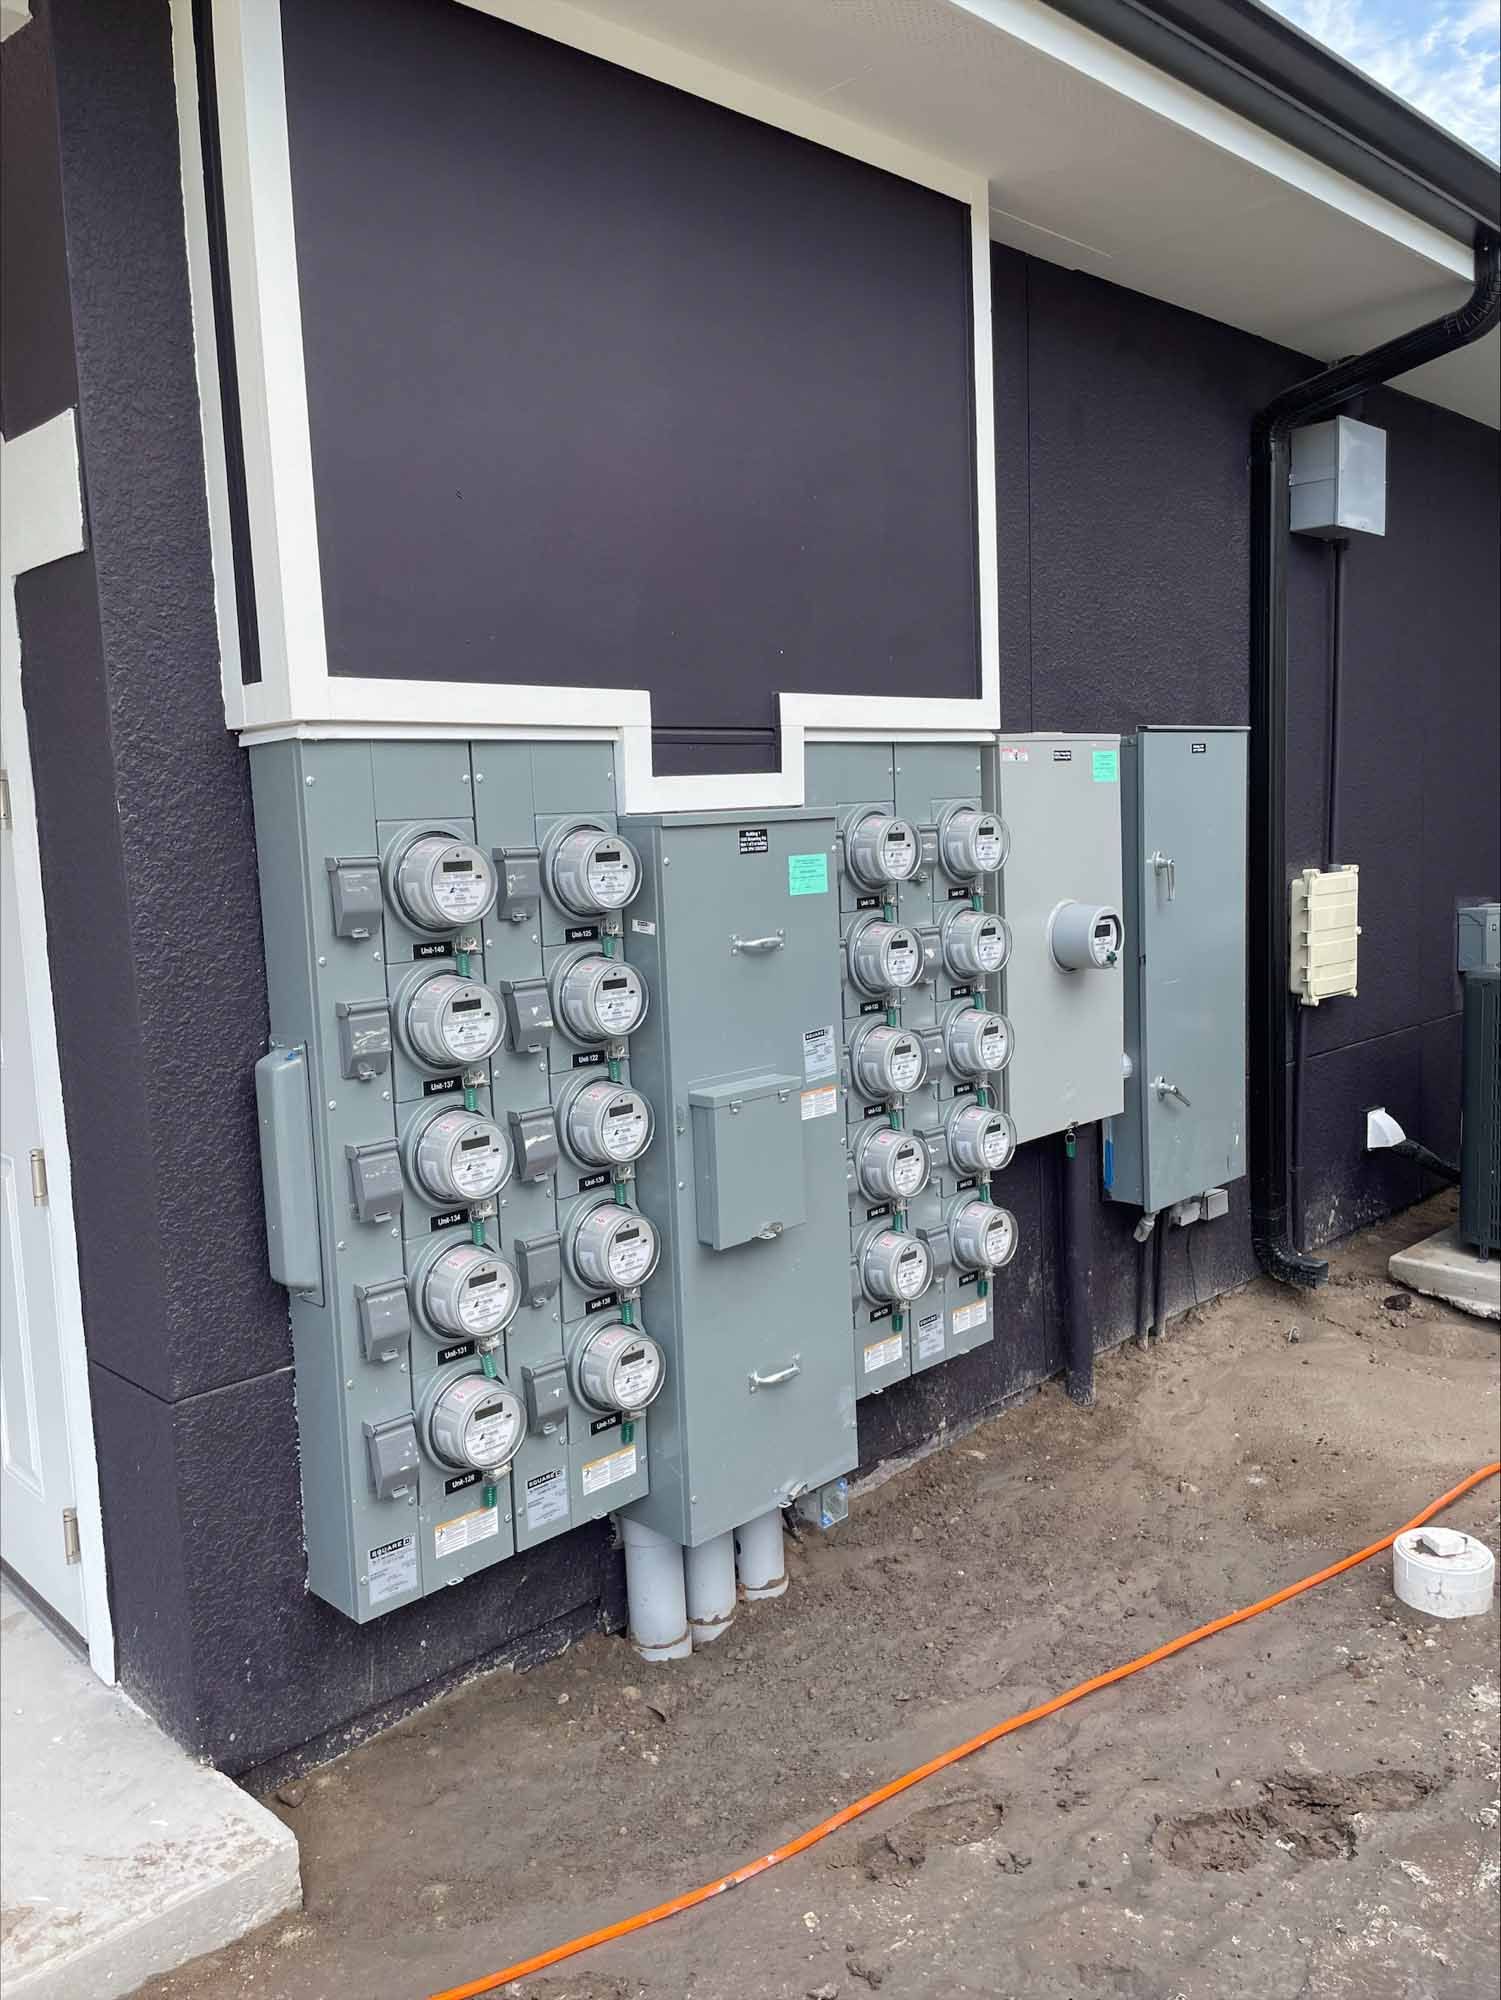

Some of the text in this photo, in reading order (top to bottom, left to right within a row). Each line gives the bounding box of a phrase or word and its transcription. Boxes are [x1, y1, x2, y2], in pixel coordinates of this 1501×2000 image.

[431, 1080, 454, 1091] Unit-137
[444, 1346, 467, 1359] Unit-131
[528, 1472, 556, 1488] SQUARE
[370, 1540, 404, 1559] SQUARE
